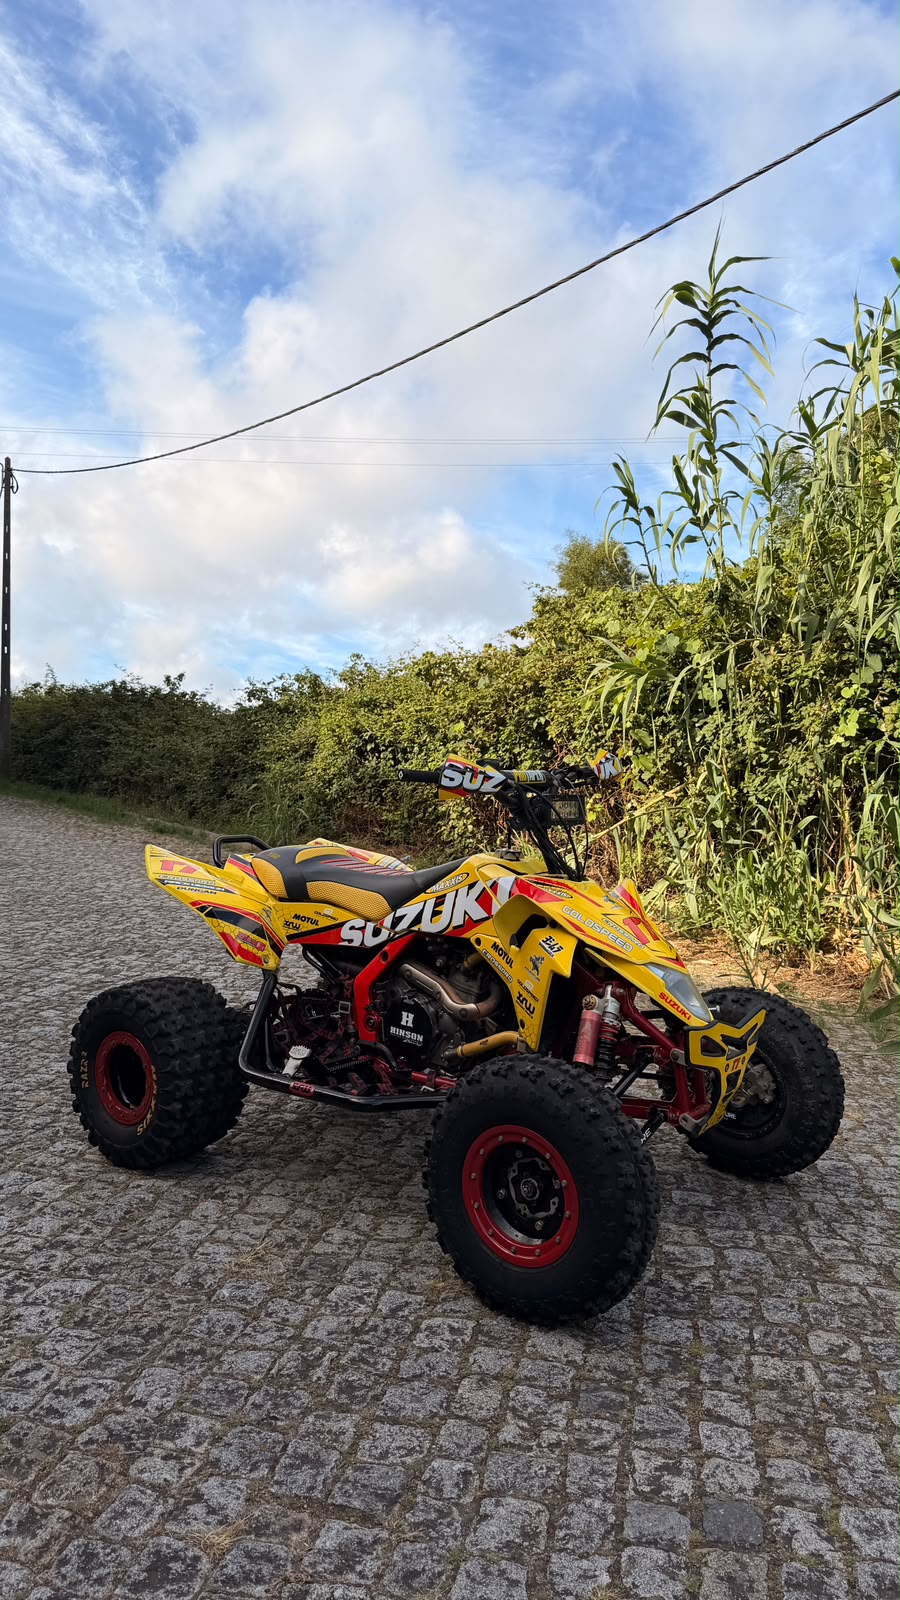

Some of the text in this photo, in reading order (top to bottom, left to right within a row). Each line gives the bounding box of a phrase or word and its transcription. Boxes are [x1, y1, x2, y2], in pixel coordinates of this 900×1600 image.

[440, 762, 507, 793] SUZ
[177, 887, 217, 895] DUNCAN
[432, 873, 465, 892] MAXXIS
[293, 913, 319, 926] MOTUL
[340, 876, 516, 947] SUZUKI
[562, 905, 634, 953] GOLDSPEED
[491, 941, 514, 969] MOTUL
[401, 1011, 414, 1027] H
[659, 992, 692, 1021] SUZUKI
[390, 1026, 424, 1042] HINSON
[80, 1059, 89, 1088] RAZR
